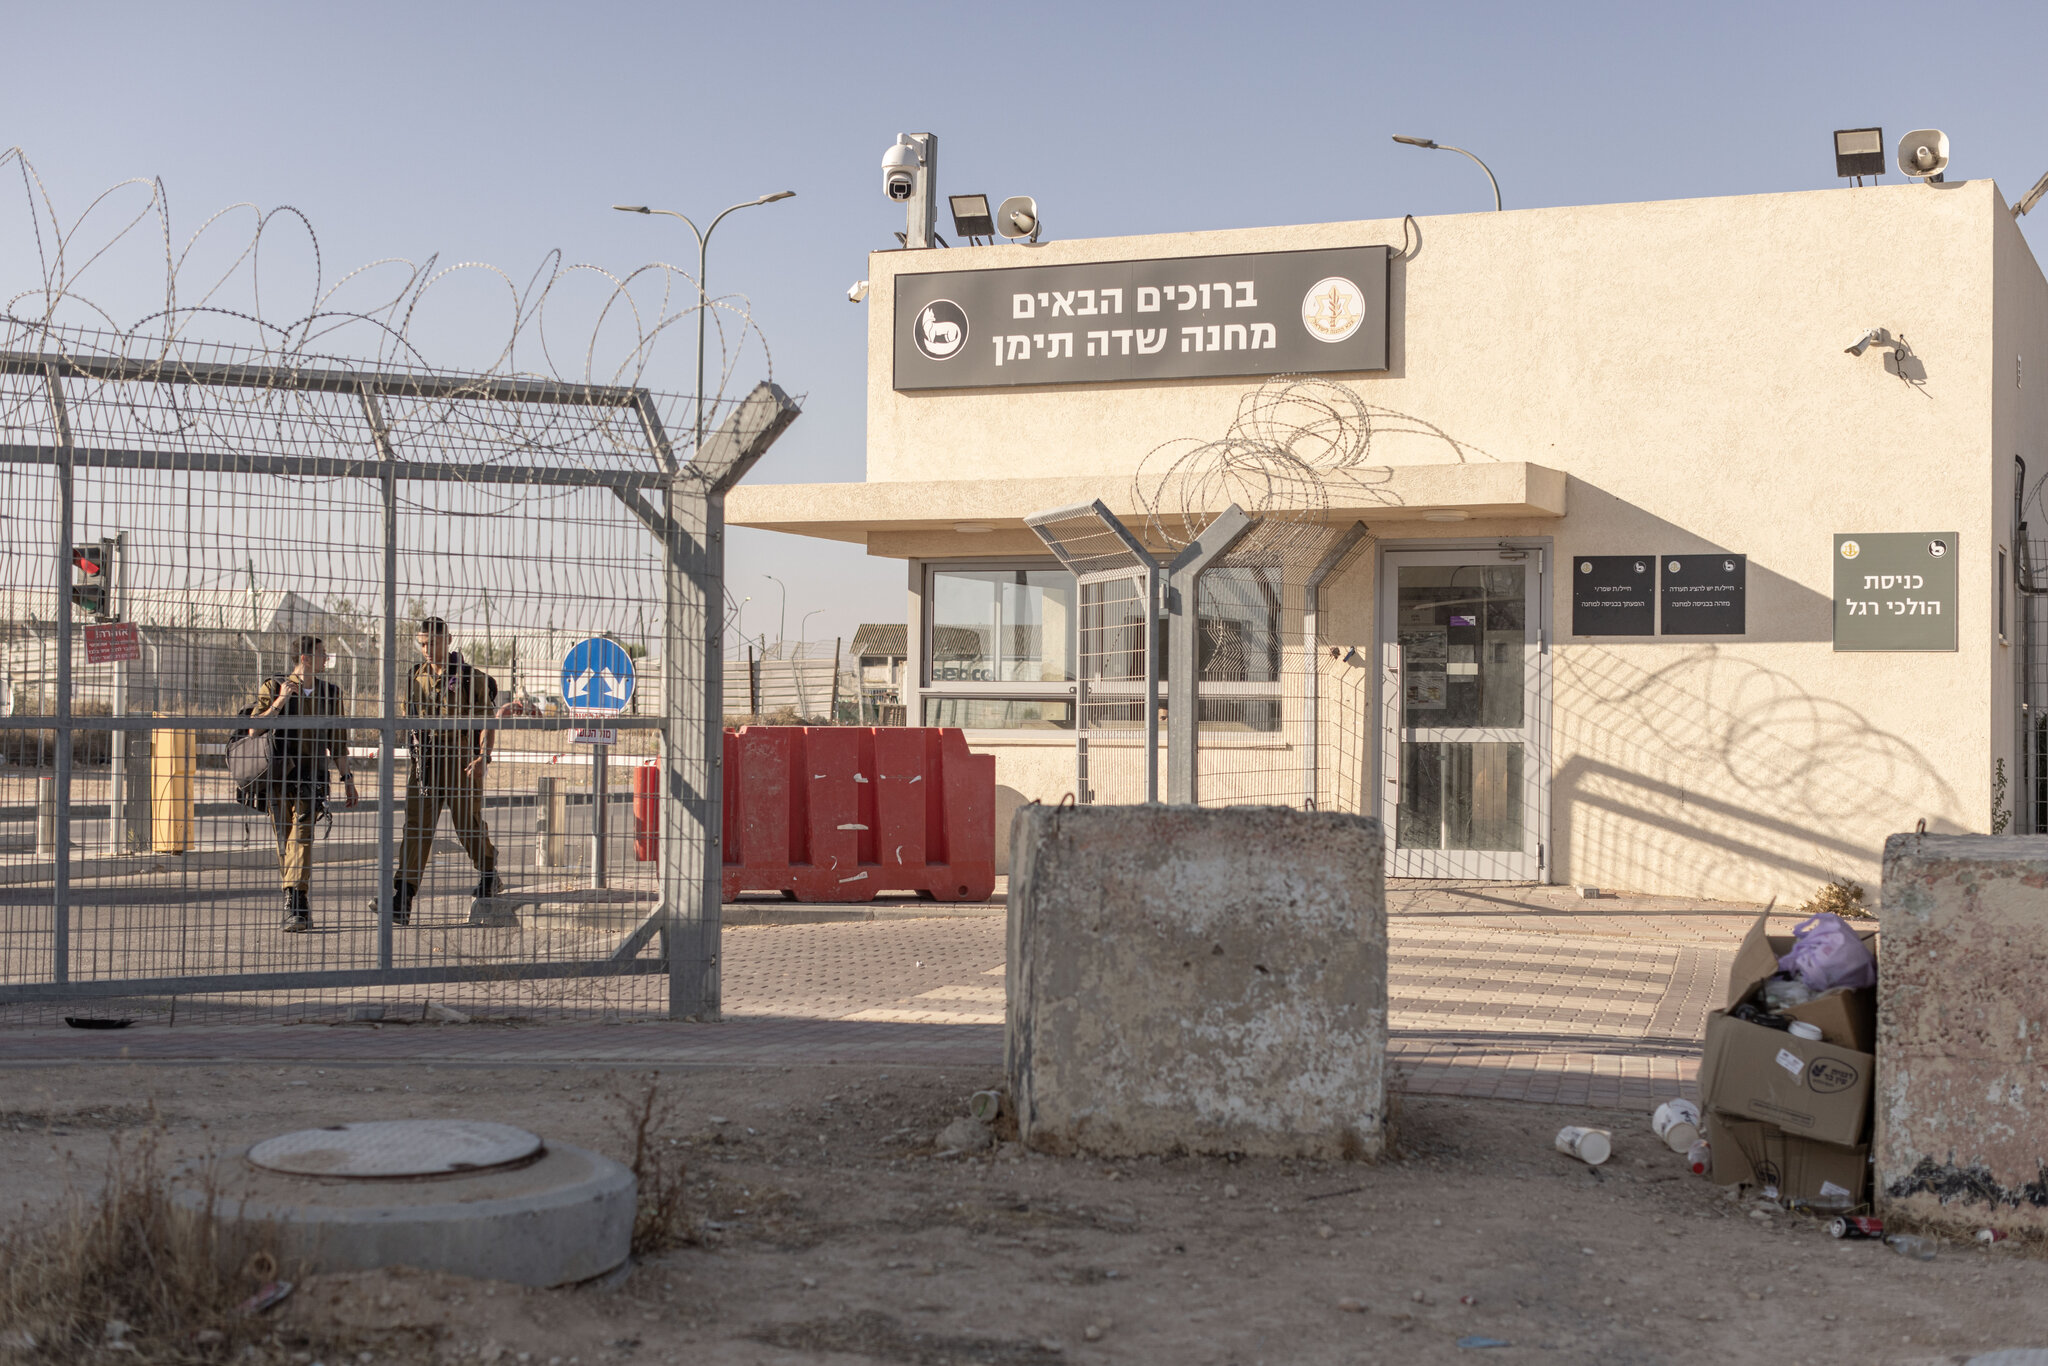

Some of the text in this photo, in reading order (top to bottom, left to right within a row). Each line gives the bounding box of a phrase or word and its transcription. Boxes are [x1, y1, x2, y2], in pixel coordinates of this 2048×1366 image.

[1013, 281, 1258, 319] ברוכים הבאים
[992, 322, 1276, 366] מחנה שדה תימן
[1864, 575, 1924, 590] כניסת
[1846, 597, 1941, 616] הולכי רגל
